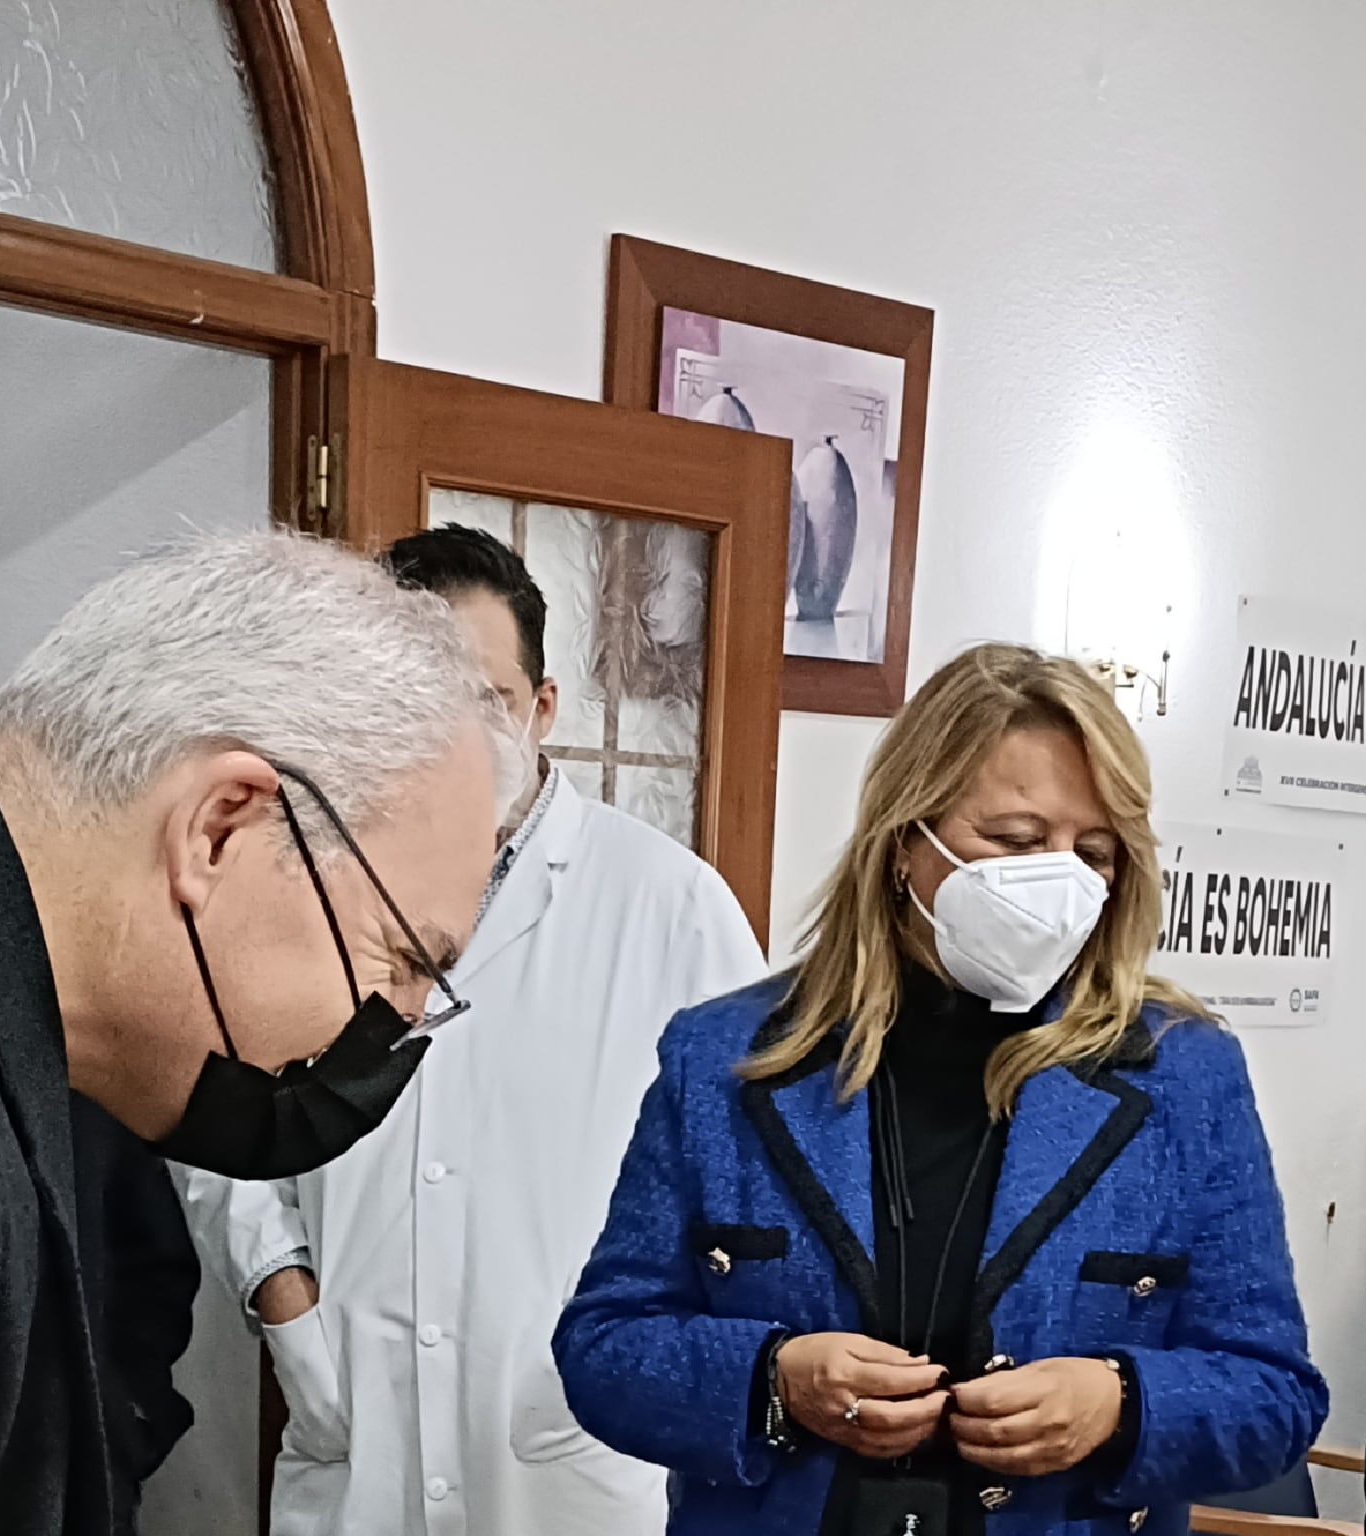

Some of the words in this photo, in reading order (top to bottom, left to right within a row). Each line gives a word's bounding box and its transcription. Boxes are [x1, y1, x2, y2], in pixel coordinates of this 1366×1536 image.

[1233, 639, 1365, 745] ANDALUCÍA
[1200, 873, 1231, 955] ES
[1233, 876, 1331, 959] BOHEMIA
